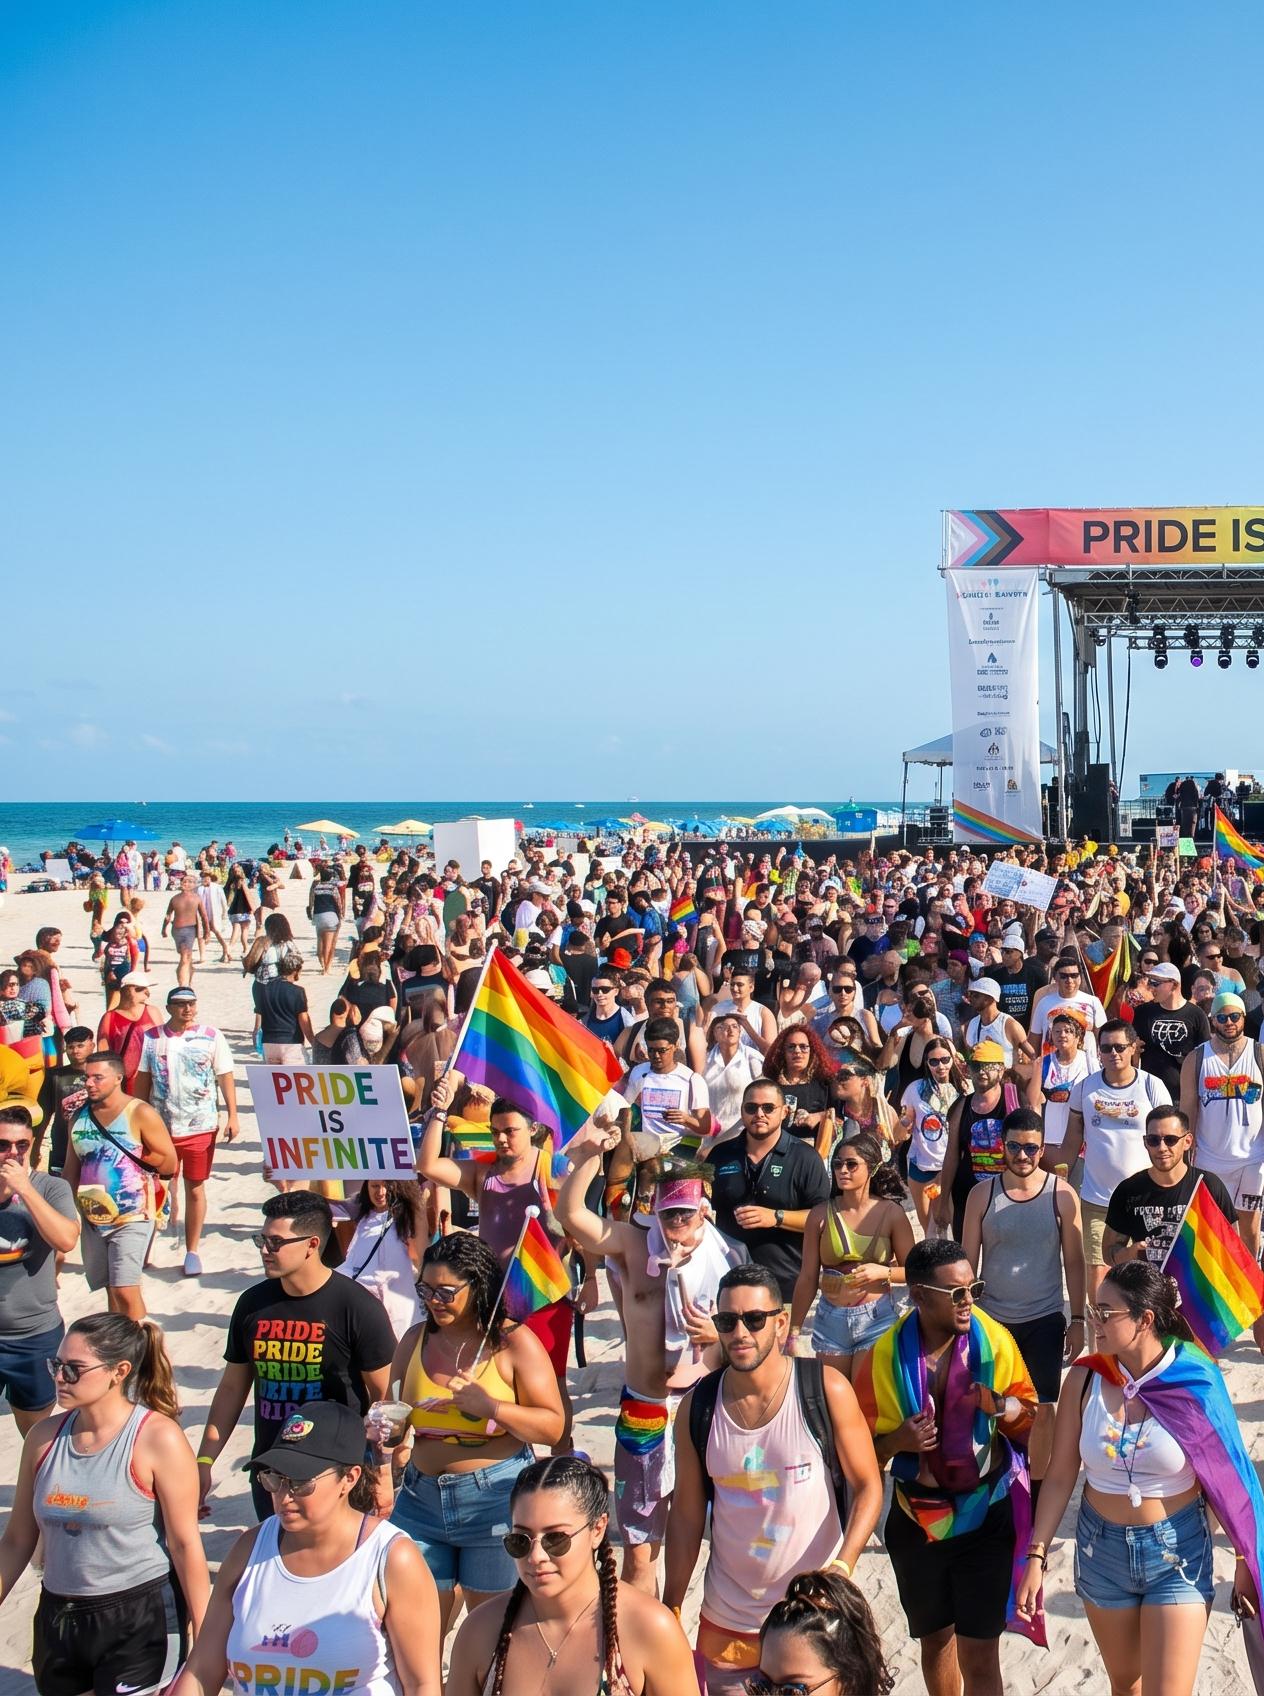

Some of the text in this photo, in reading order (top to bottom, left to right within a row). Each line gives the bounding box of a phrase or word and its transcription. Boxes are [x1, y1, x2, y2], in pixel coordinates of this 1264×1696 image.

[1083, 518, 1217, 554] PRIDE
[271, 1072, 378, 1105] PRIDE
[318, 1110, 345, 1133] IS
[266, 1137, 413, 1170] INFINITE
[255, 1319, 326, 1341] PRIDE
[253, 1340, 323, 1362] PRIDE
[255, 1361, 324, 1381] PRIDE
[233, 1662, 360, 1696] PRIDE
